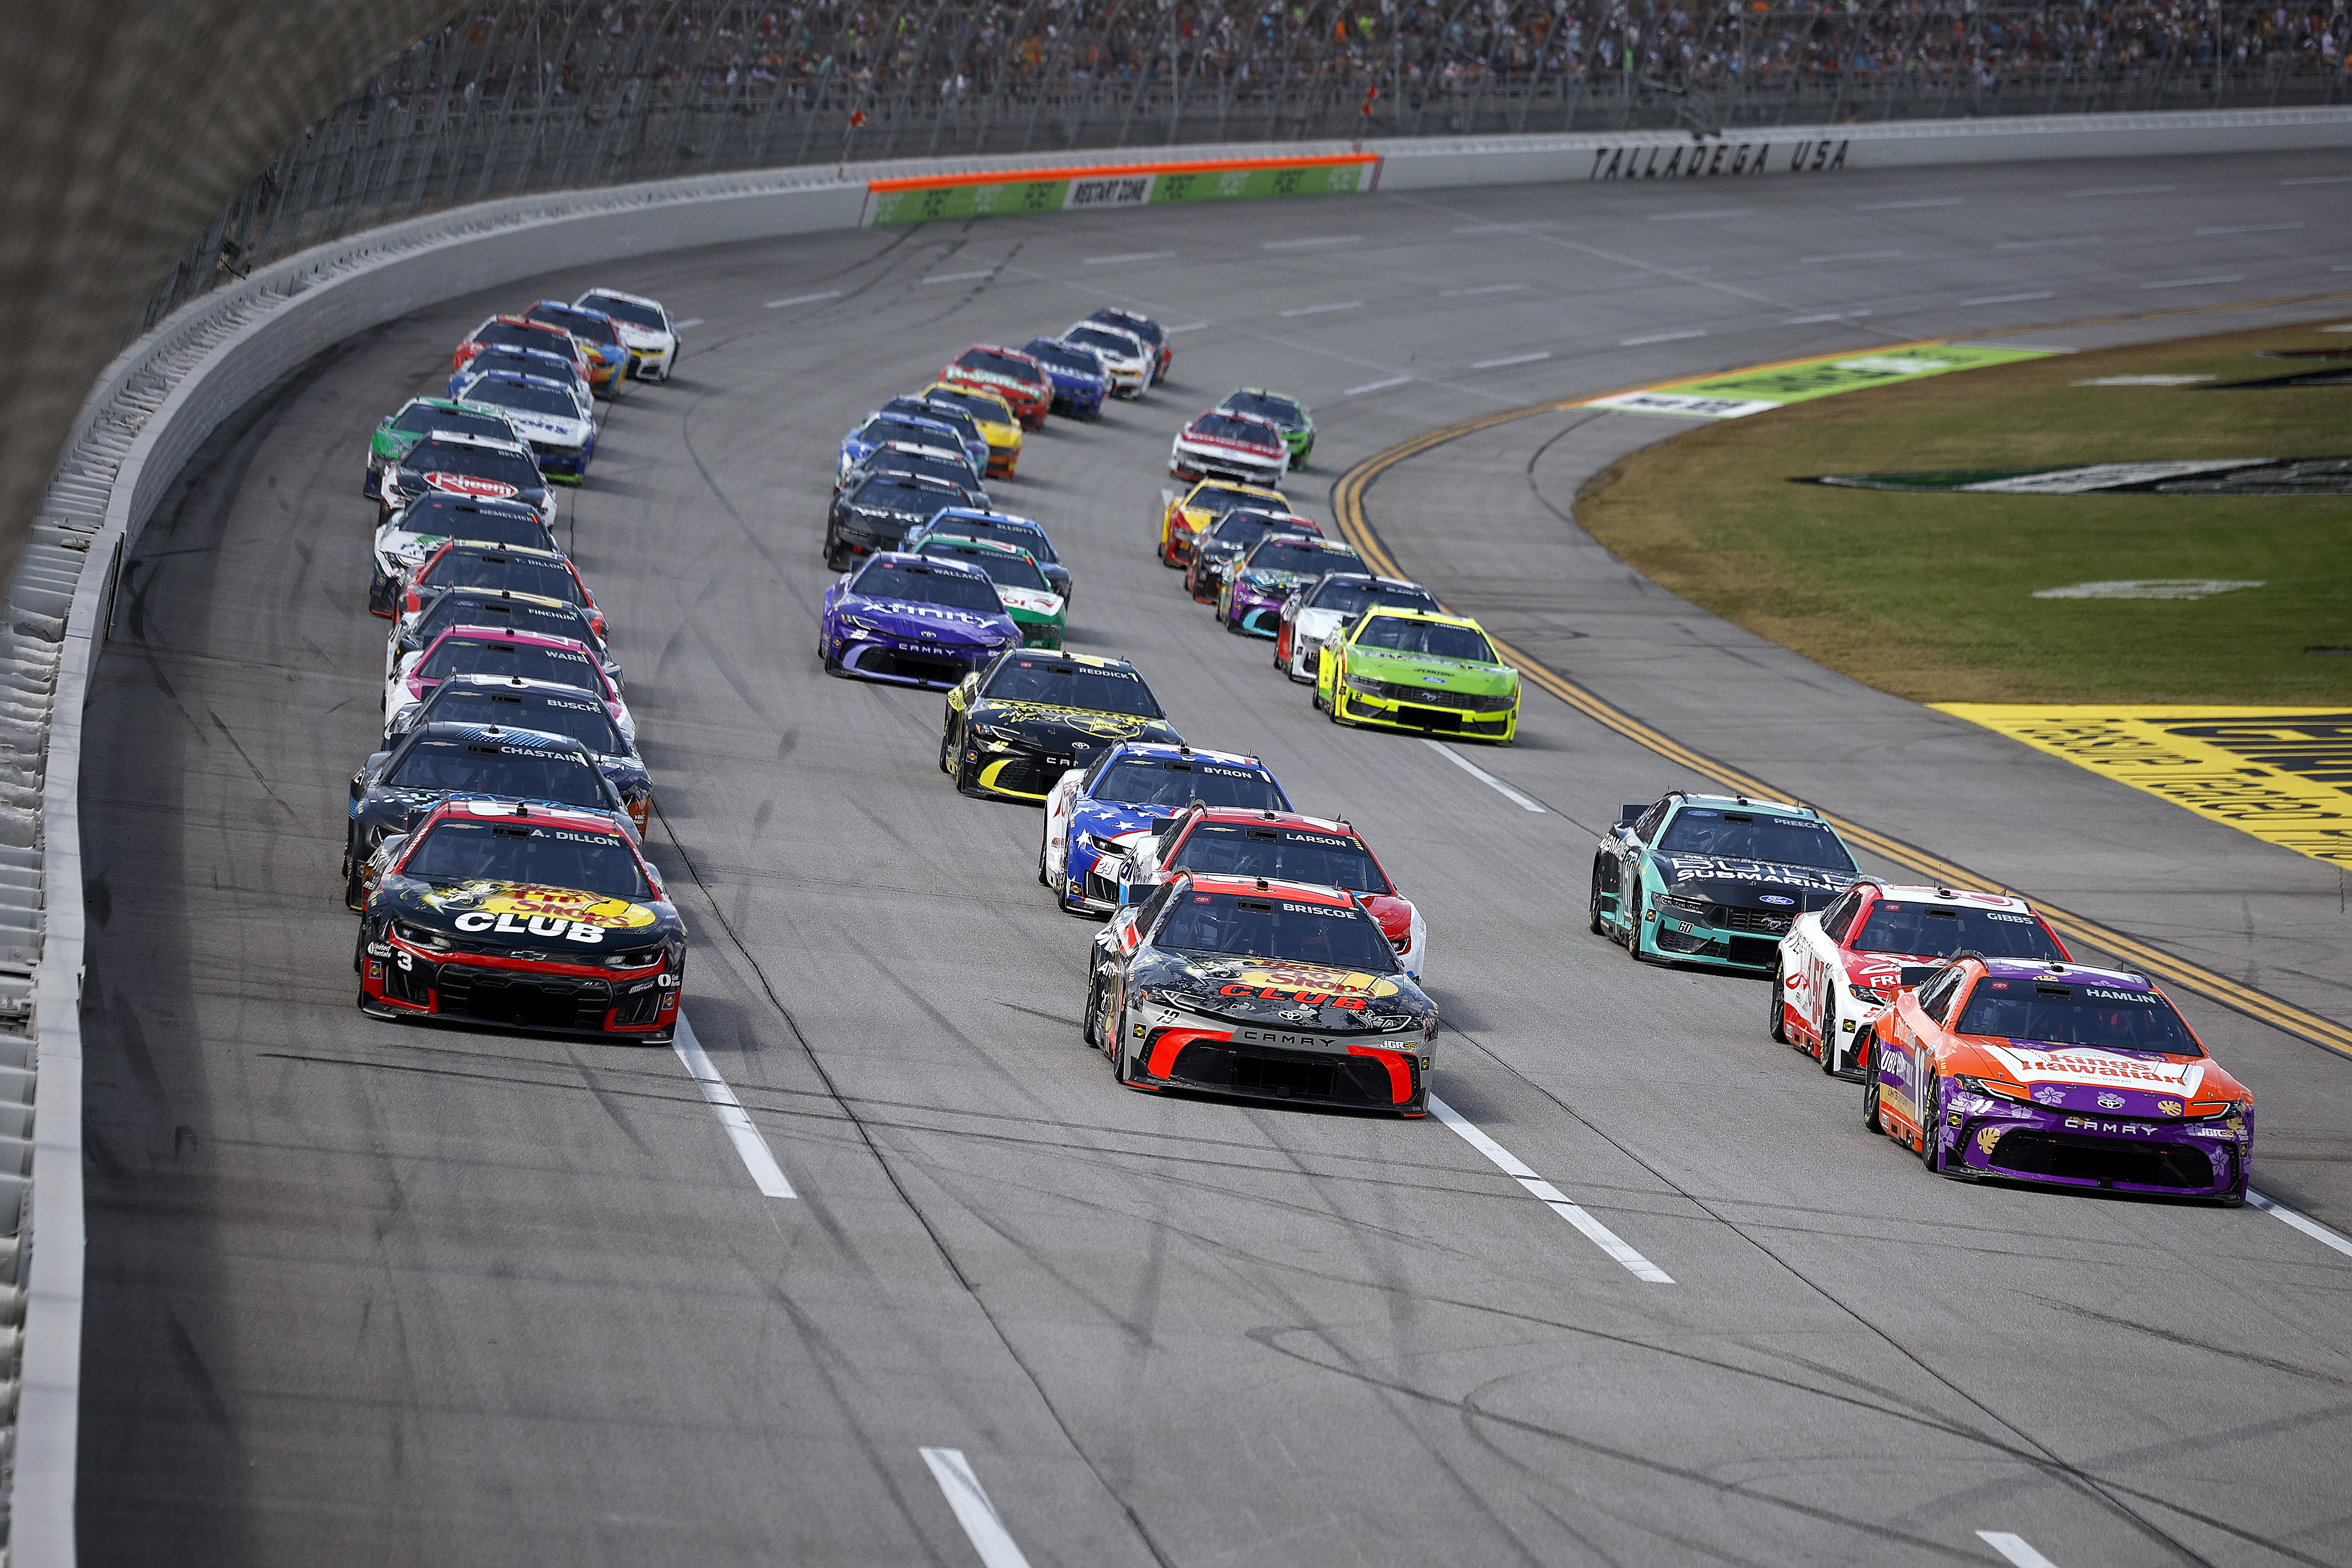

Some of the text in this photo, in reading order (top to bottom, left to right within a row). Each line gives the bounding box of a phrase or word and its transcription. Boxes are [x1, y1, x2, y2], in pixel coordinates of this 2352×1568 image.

[1590, 140, 1850, 181] TALLADEGA USA
[434, 471, 512, 496] Rheem
[528, 608, 576, 621] FINCHUM
[862, 602, 999, 629] xfinity
[545, 650, 586, 663] WARE
[898, 643, 956, 656] CAMRY
[1079, 667, 1129, 679] REDDICK
[547, 699, 597, 713] BUSCH
[501, 746, 581, 763] CHASTAIN
[1203, 766, 1252, 780] BYRON
[1773, 818, 1820, 829] PREECE
[530, 829, 621, 847] A. DILLON
[1285, 832, 1347, 847] LARSON
[1097, 861, 1116, 875] 24
[1766, 895, 1788, 904] Ford
[510, 898, 629, 927] Shops
[1283, 903, 1357, 920] BRISCOE
[1987, 912, 2033, 925] GIBBS
[455, 912, 606, 944] CLUB
[1679, 921, 1693, 934] 60
[373, 949, 391, 958] Rentals
[374, 943, 391, 952] United
[397, 951, 413, 972] 3
[1268, 968, 1332, 980] Pro
[1265, 973, 1376, 996] Shops
[1220, 984, 1368, 1010] CLUB
[2086, 987, 2156, 1005] HAMLIN
[1155, 1009, 1181, 1024] 19
[1244, 1031, 1336, 1047] CAMRY
[2047, 1054, 2150, 1071] King's
[2021, 1060, 2186, 1086] Hawaiian
[1969, 1098, 1996, 1114] 11
[2064, 1119, 2159, 1136] CAMRY
